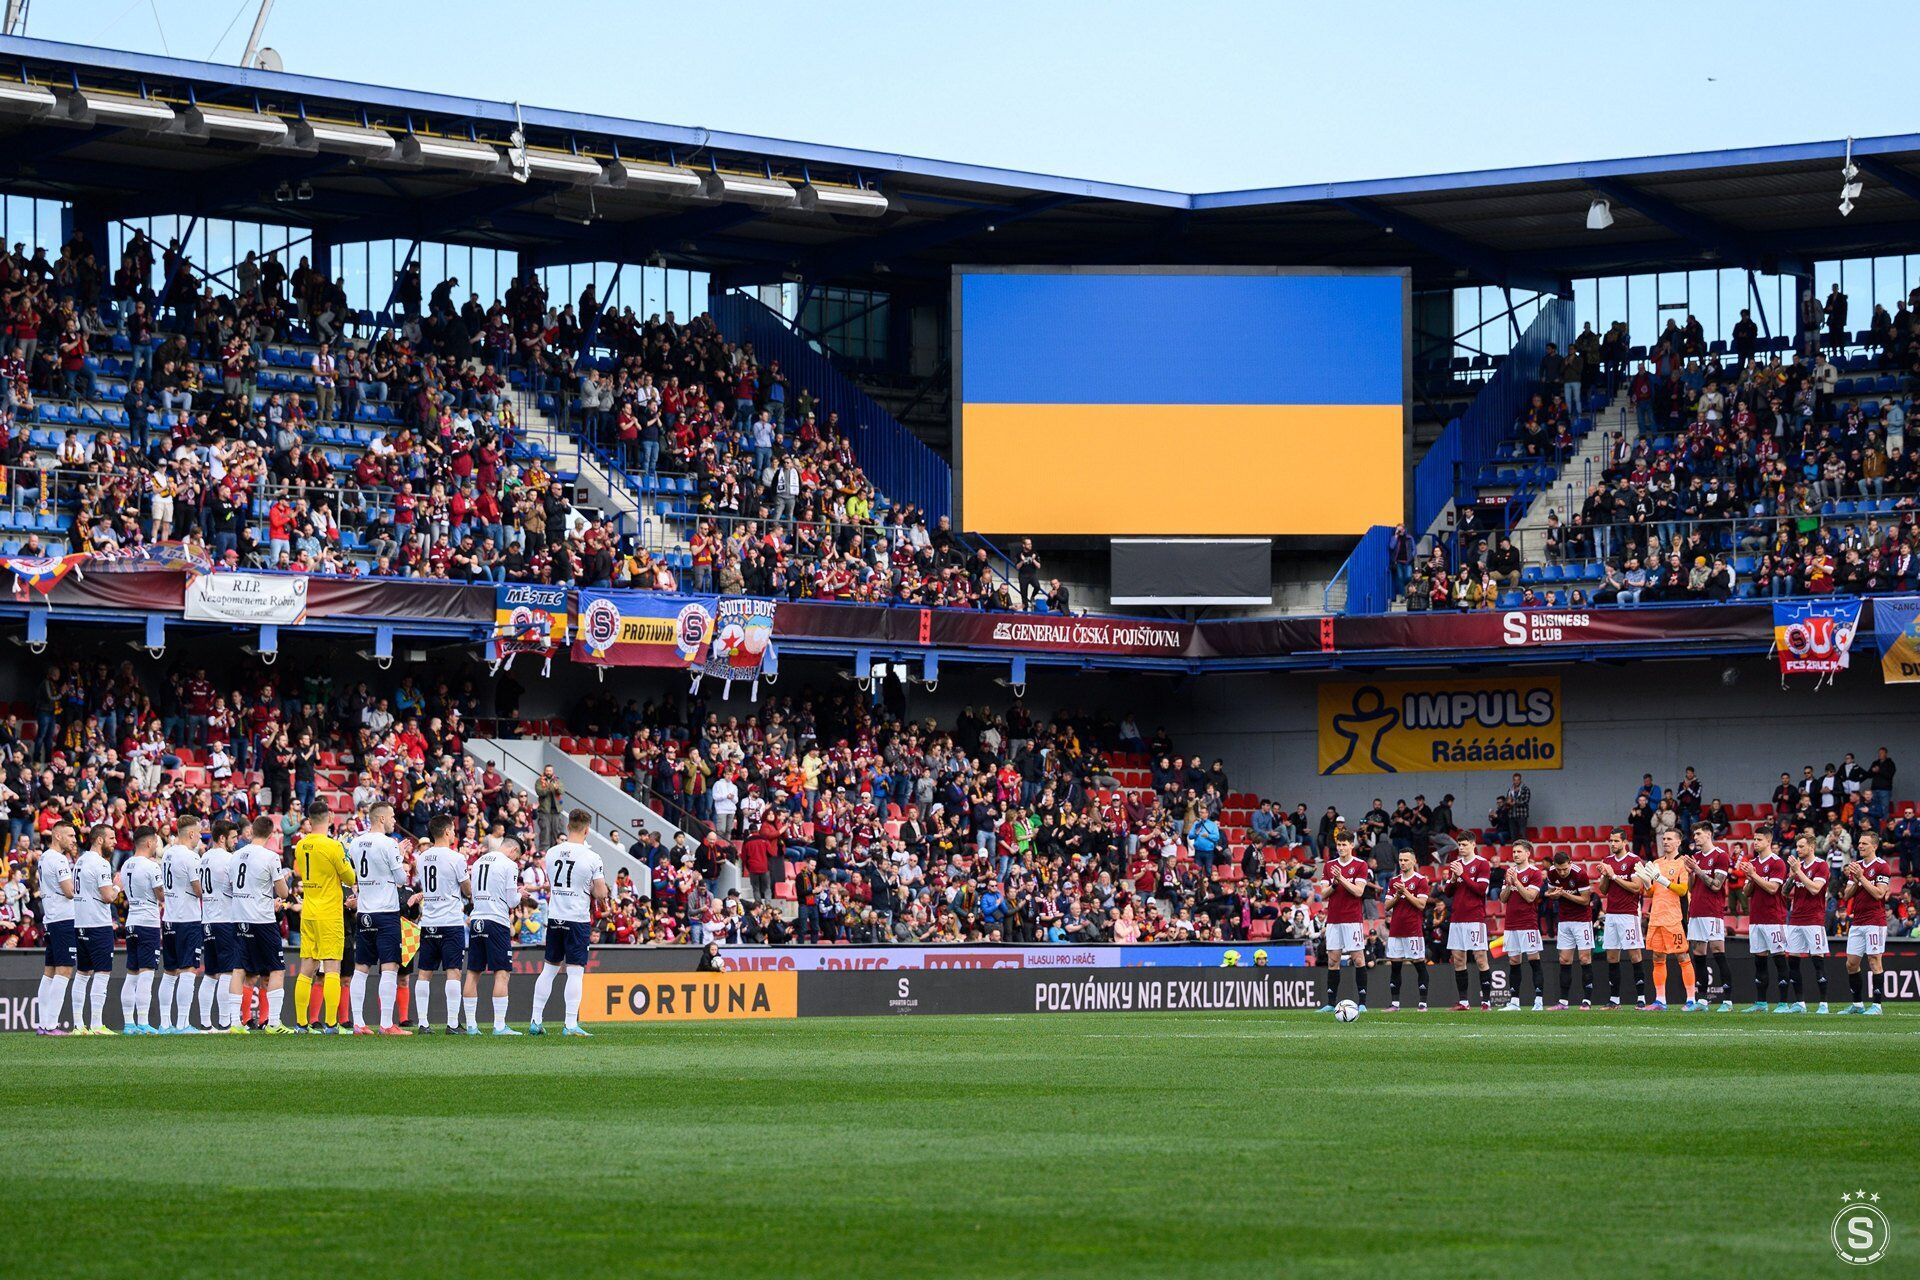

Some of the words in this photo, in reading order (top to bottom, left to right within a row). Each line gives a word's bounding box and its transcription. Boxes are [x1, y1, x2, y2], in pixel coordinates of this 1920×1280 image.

[232, 580, 260, 593] R.I.P.
[506, 586, 564, 605] MĚSTEC
[719, 600, 752, 616] SOUTH
[594, 609, 611, 639] S
[685, 614, 702, 642] S
[1503, 611, 1527, 645] S
[1531, 614, 1590, 628] BUSINESS
[1012, 623, 1069, 643] GENERALI
[1073, 623, 1109, 645] ČESKÁ
[1112, 625, 1180, 647] POJIŠŤOVNA
[1532, 628, 1562, 641] CLUB
[1786, 660, 1805, 670] FCS
[1403, 688, 1554, 730] IMPULS
[1432, 737, 1555, 763] Ráááádio
[305, 852, 310, 880] 1
[360, 850, 369, 878] 6
[236, 863, 247, 889] 8
[424, 865, 437, 892] 18
[478, 864, 490, 891] 11
[553, 859, 576, 888] 27
[1584, 930, 1589, 940] 8
[1625, 929, 1635, 941] 33
[1710, 921, 1715, 932] 7
[1353, 931, 1360, 942] 41
[1470, 931, 1480, 942] 37
[1527, 931, 1536, 943] 16
[1673, 933, 1683, 945] 29
[1771, 931, 1781, 944] 20
[1815, 934, 1820, 945] 9
[1869, 934, 1878, 946] 10
[1410, 940, 1419, 951] 21
[1028, 954, 1054, 965] HLASUJ
[1056, 954, 1071, 965] PRO
[1072, 952, 1096, 965] HRÁČE
[898, 977, 909, 997] S
[1491, 970, 1506, 990] S
[606, 983, 771, 1015] FORTUNA
[1036, 975, 1133, 1011] POZVÁNKY
[1139, 981, 1161, 1009] NA
[1167, 974, 1269, 1009] EXKLUZIVNÍ
[1273, 980, 1321, 1008] AKCE.
